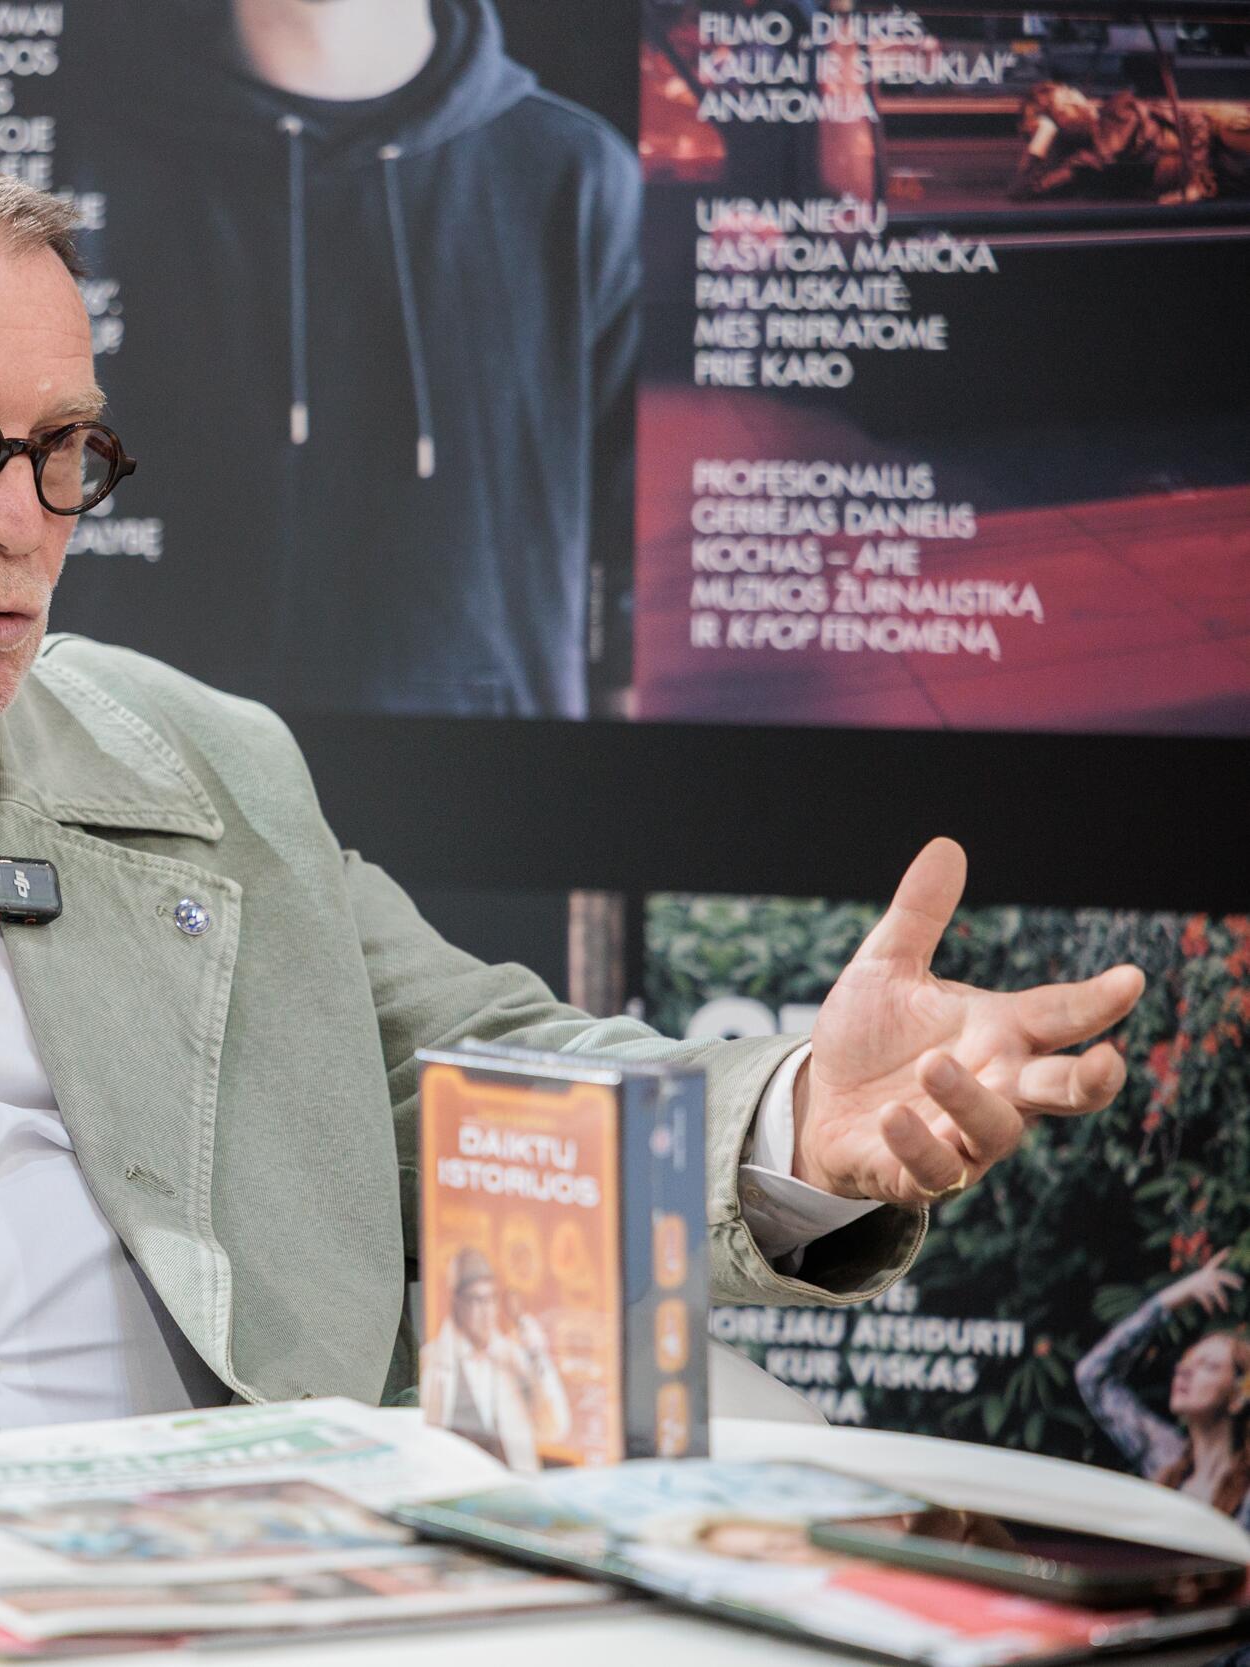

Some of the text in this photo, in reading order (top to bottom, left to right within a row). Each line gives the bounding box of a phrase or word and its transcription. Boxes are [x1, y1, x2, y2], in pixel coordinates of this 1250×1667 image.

[699, 11, 793, 46] FILMO
[699, 51, 810, 84] KAULAI
[698, 87, 880, 123] ANATOMIJA
[694, 313, 762, 349] MES
[694, 350, 855, 389] PRIE KARO
[691, 536, 824, 574] KOCHAS
[853, 540, 921, 577] APIE
[690, 574, 830, 613] MUZIKOS
[690, 611, 723, 650] IR
[851, 1312, 1025, 1357] ATSIDURTI
[764, 1347, 980, 1394] KUR VISKAS
